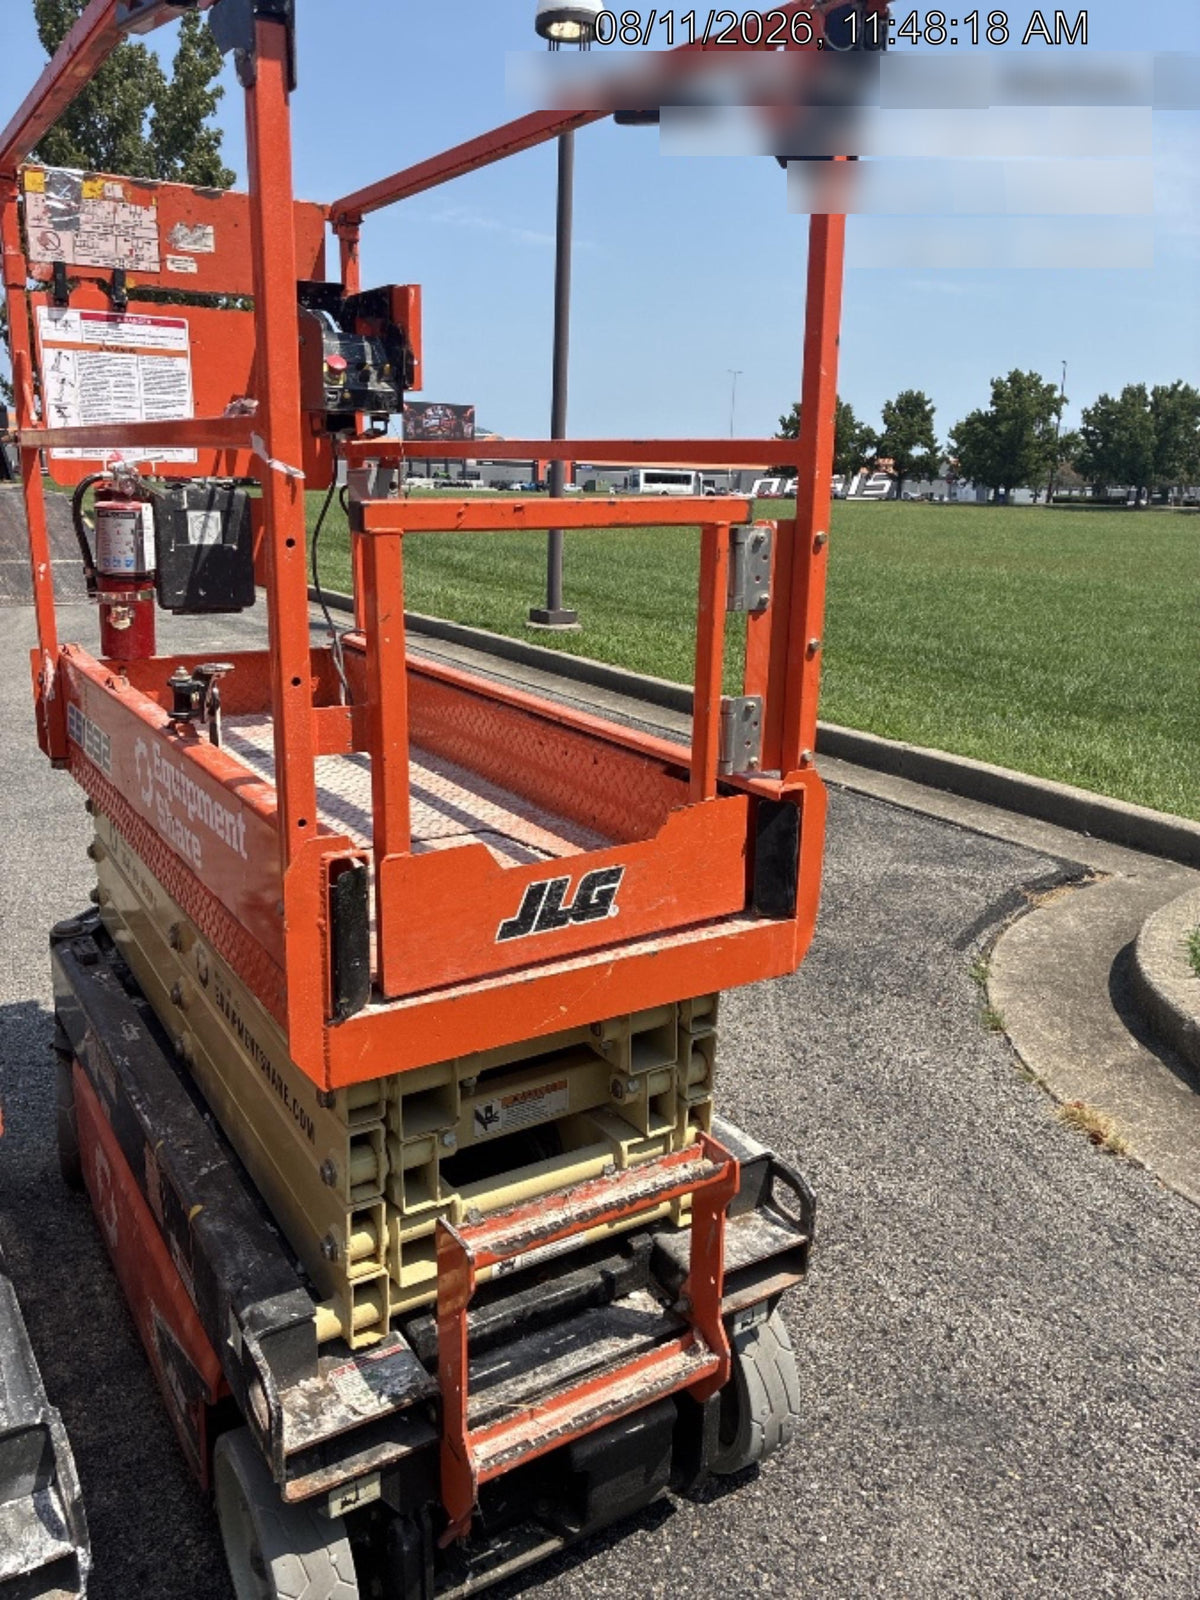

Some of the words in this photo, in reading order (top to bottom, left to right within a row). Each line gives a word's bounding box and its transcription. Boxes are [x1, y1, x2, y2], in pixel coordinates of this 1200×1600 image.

[152, 740, 248, 860] Equipment
[156, 791, 202, 869] Share
[495, 864, 626, 944] JLG
